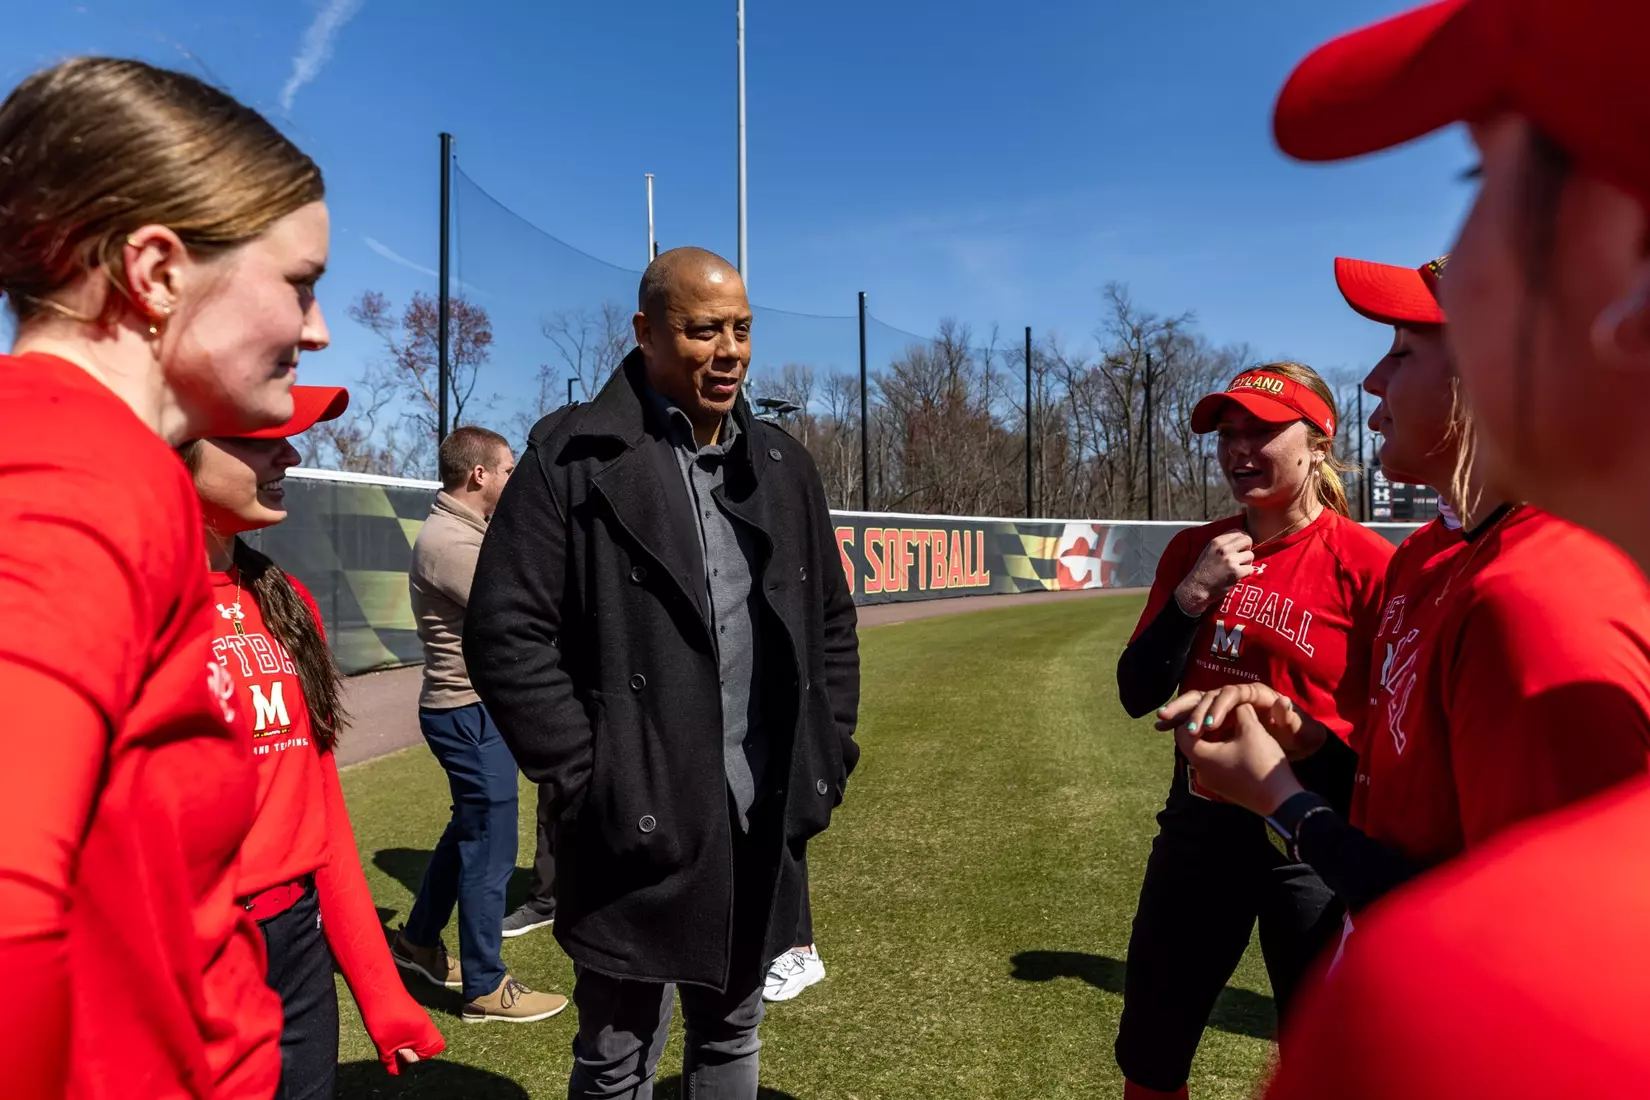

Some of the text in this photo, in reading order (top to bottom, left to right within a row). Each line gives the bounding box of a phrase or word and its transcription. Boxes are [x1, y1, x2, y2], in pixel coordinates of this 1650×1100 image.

[864, 528, 990, 594] SOFTBALL
[1210, 619, 1246, 658] M
[249, 681, 291, 731] M
